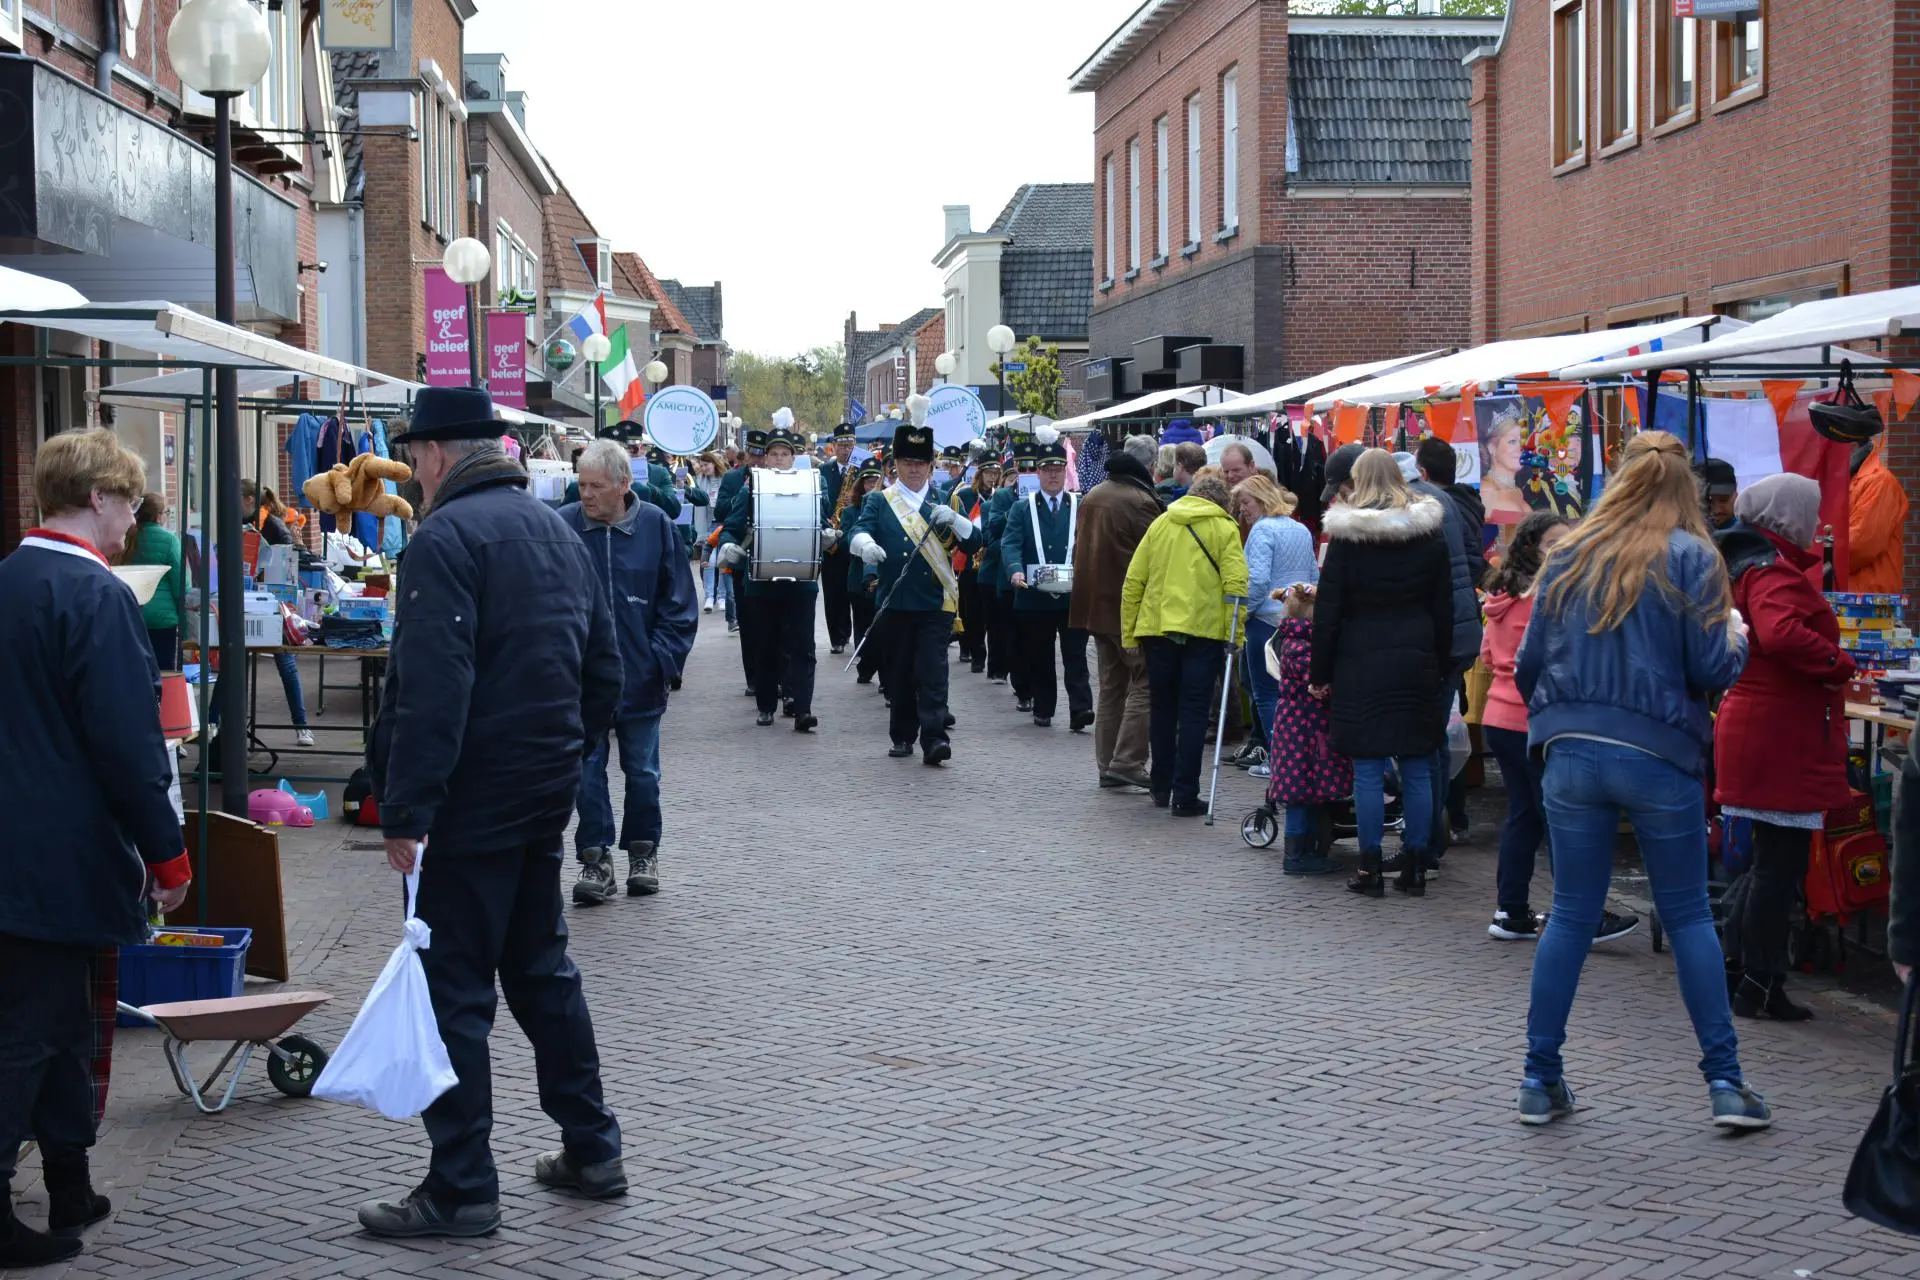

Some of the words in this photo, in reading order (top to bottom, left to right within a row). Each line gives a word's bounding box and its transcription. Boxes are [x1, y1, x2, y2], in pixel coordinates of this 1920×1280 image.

[433, 306, 465, 324] geef
[439, 321, 464, 339] &
[430, 340, 469, 353] beleef
[495, 342, 520, 355] geef
[498, 354, 518, 368] &
[491, 369, 523, 379] beleef
[656, 402, 705, 414] AMICITIA
[927, 395, 969, 418] AMICITIA
